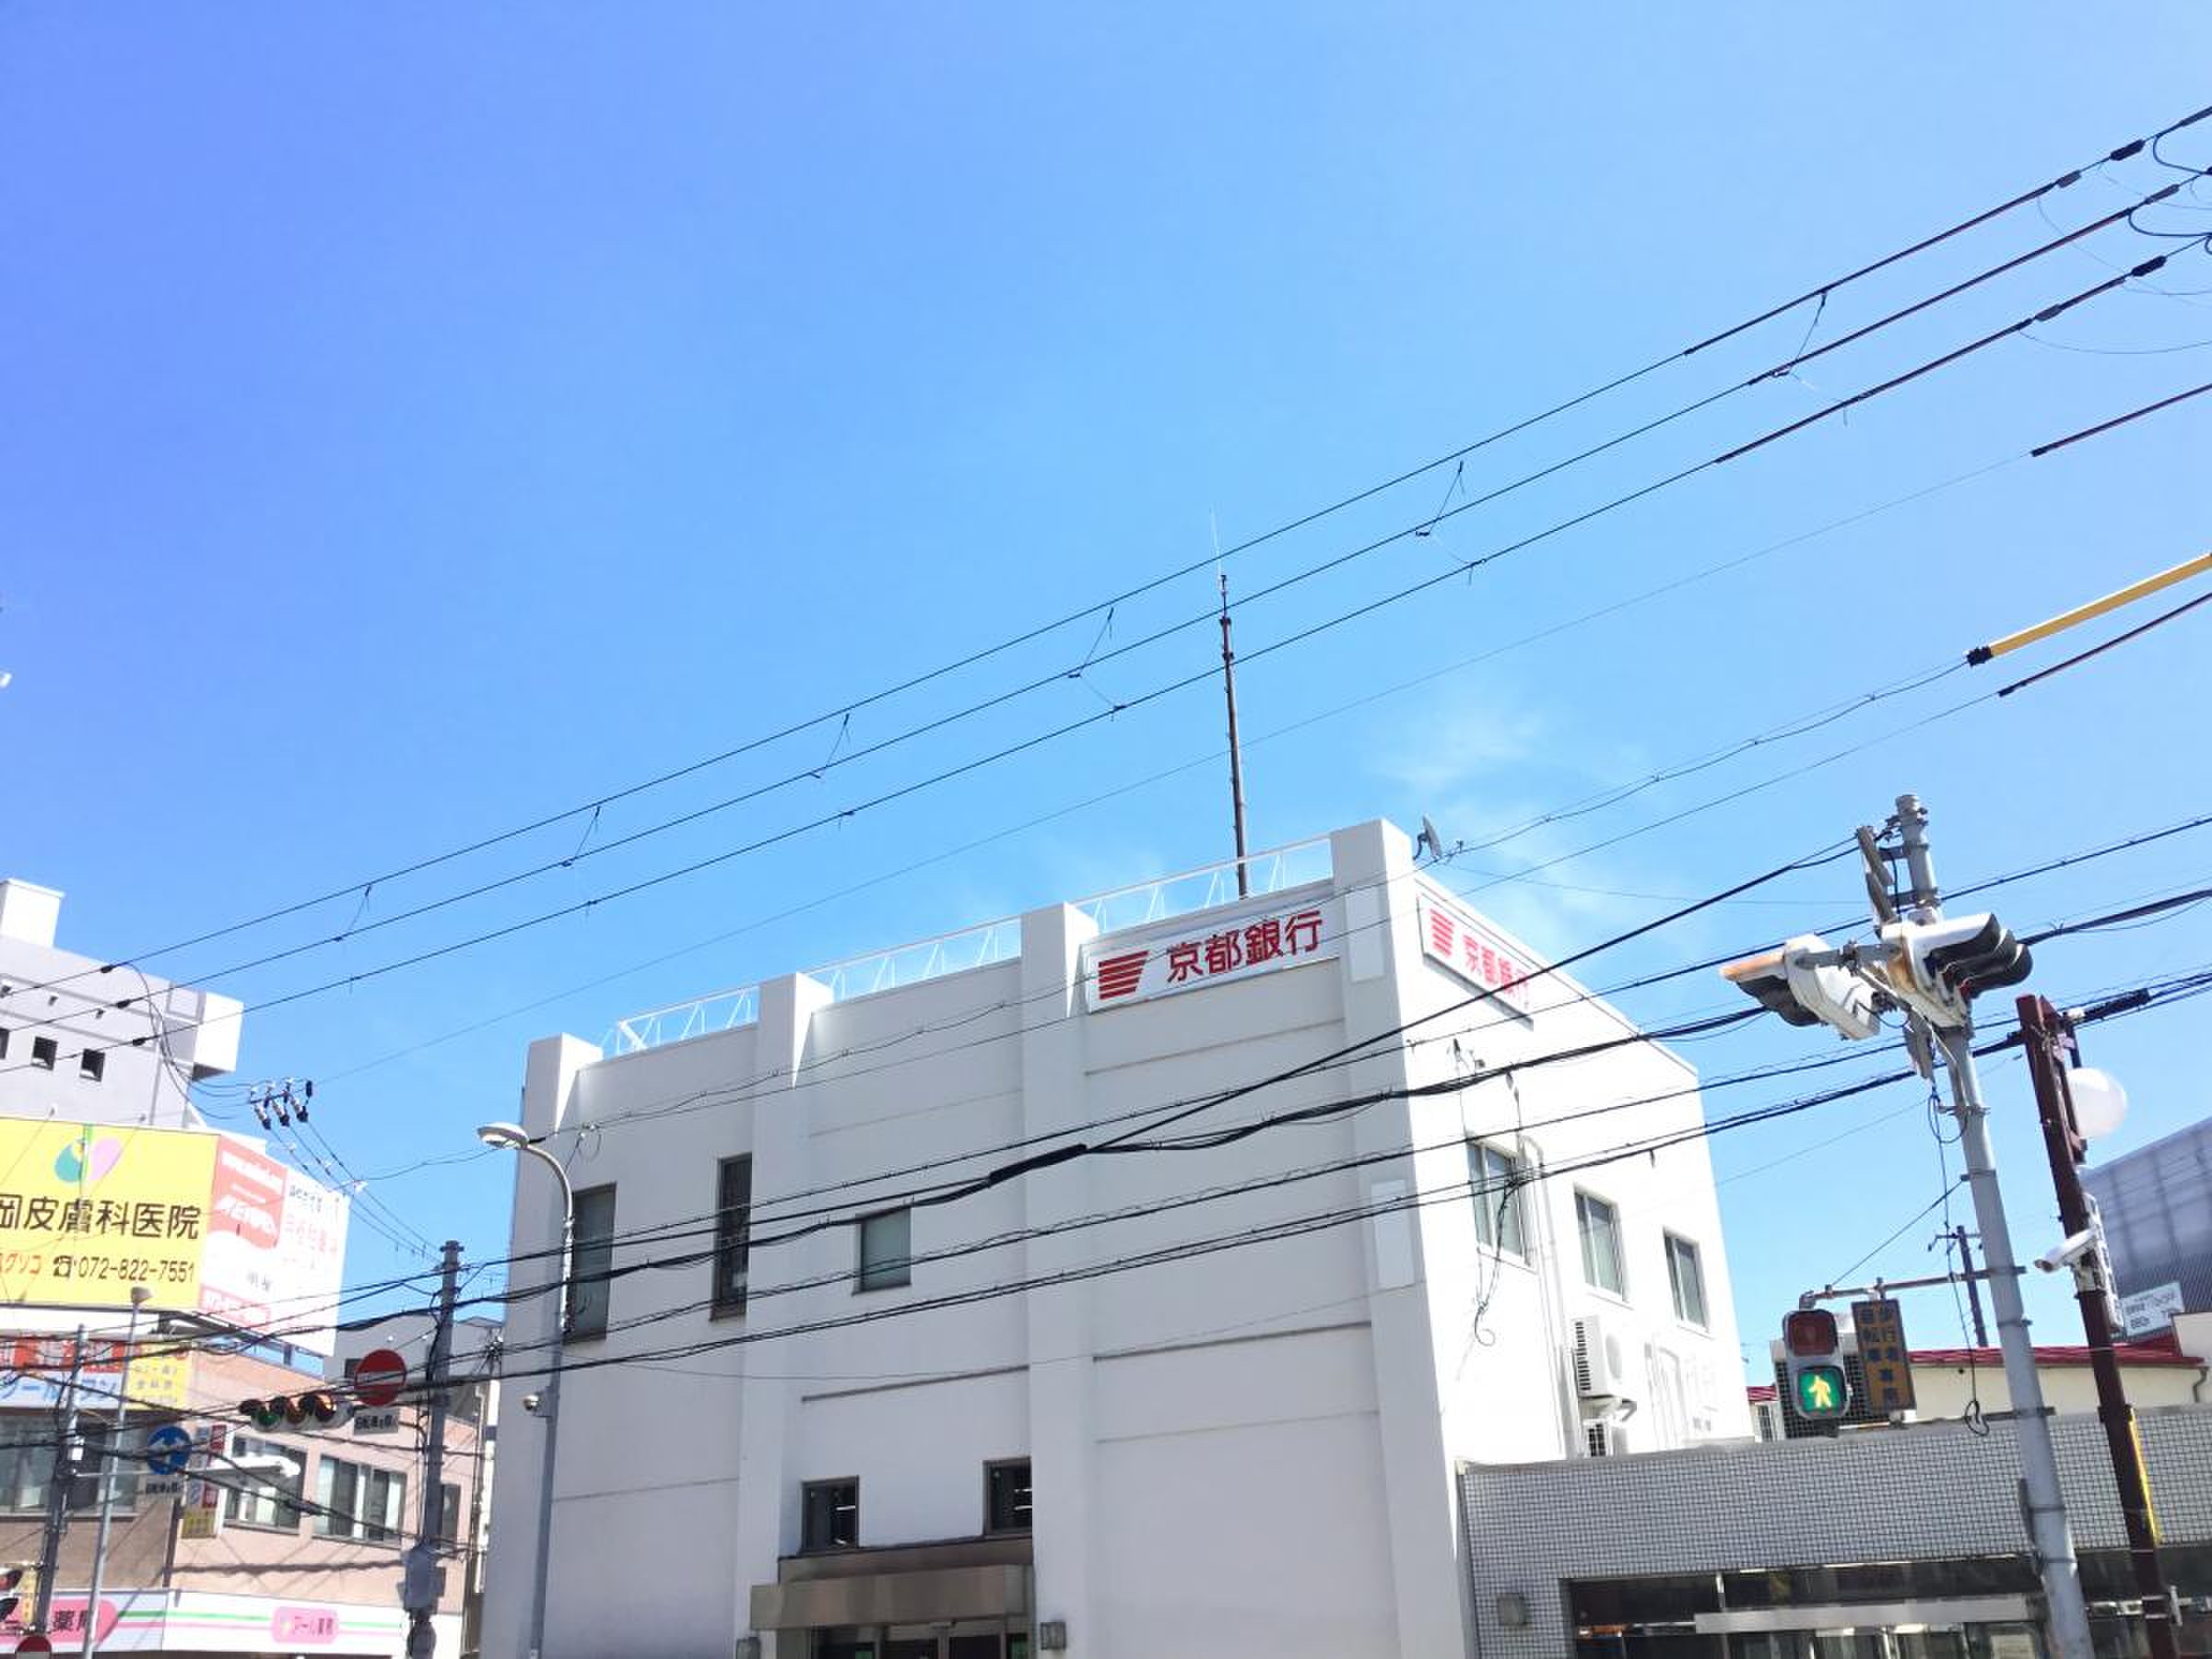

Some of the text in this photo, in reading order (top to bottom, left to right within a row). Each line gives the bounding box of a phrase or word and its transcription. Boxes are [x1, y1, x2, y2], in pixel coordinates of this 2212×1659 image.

[1166, 911, 1323, 982] 京都銀行
[78, 1255, 194, 1283] 072-822-7551
